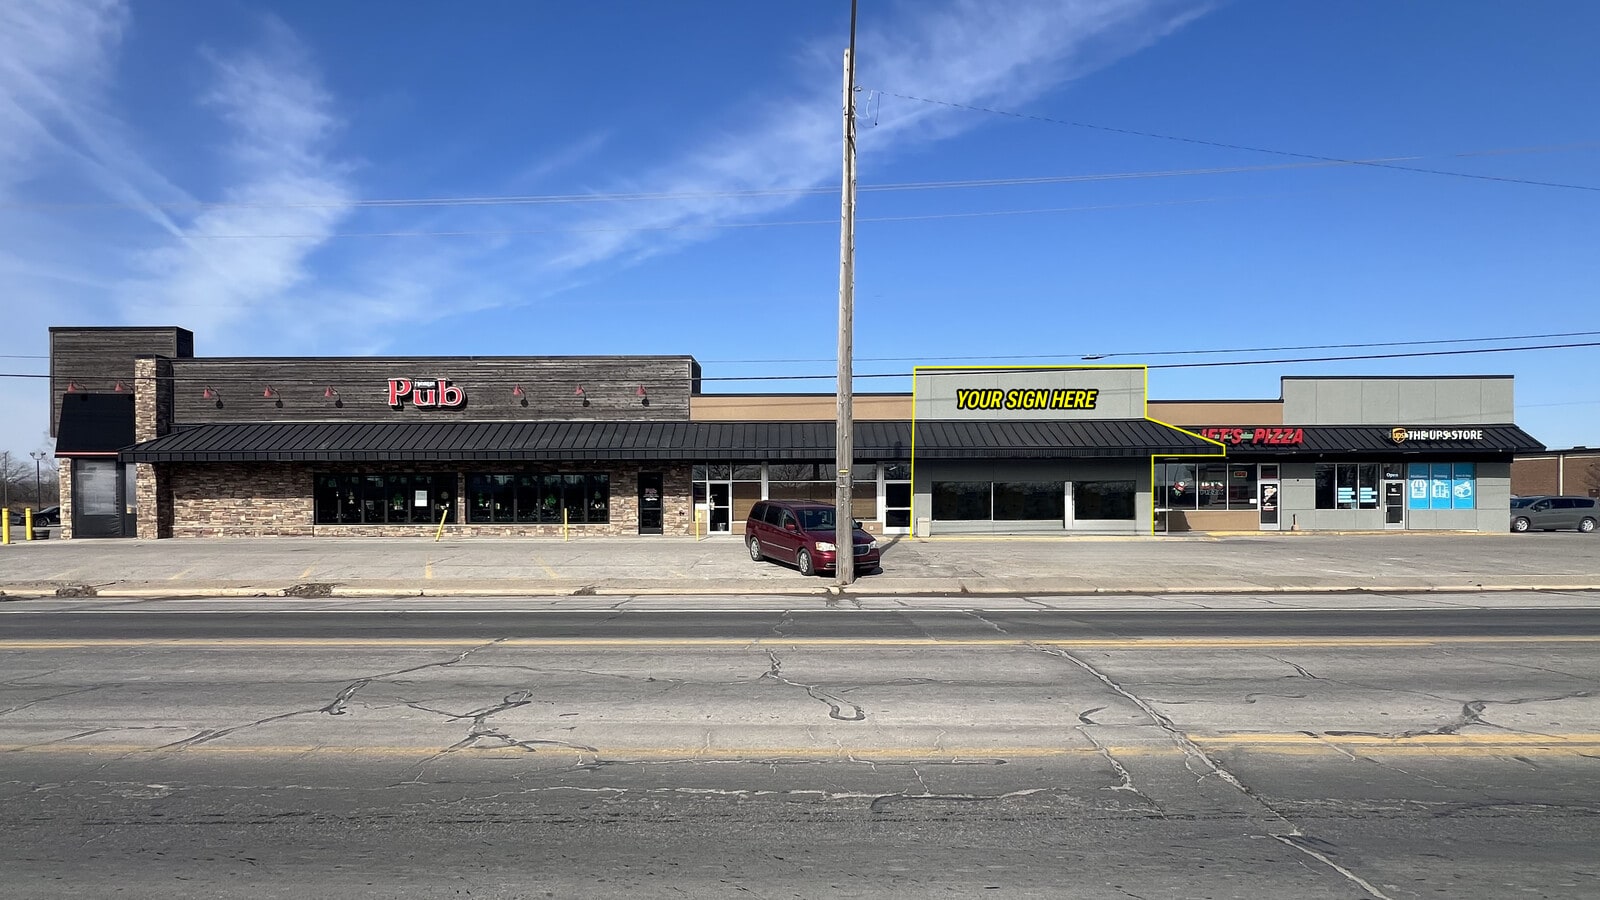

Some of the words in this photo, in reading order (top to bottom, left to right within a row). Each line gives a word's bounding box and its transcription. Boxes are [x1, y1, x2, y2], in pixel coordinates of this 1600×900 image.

[387, 377, 463, 406] Pub
[1252, 428, 1304, 444] PIZZA
[1407, 430, 1426, 440] THE
[1429, 430, 1448, 440] UPS
[1451, 430, 1483, 440] STORE
